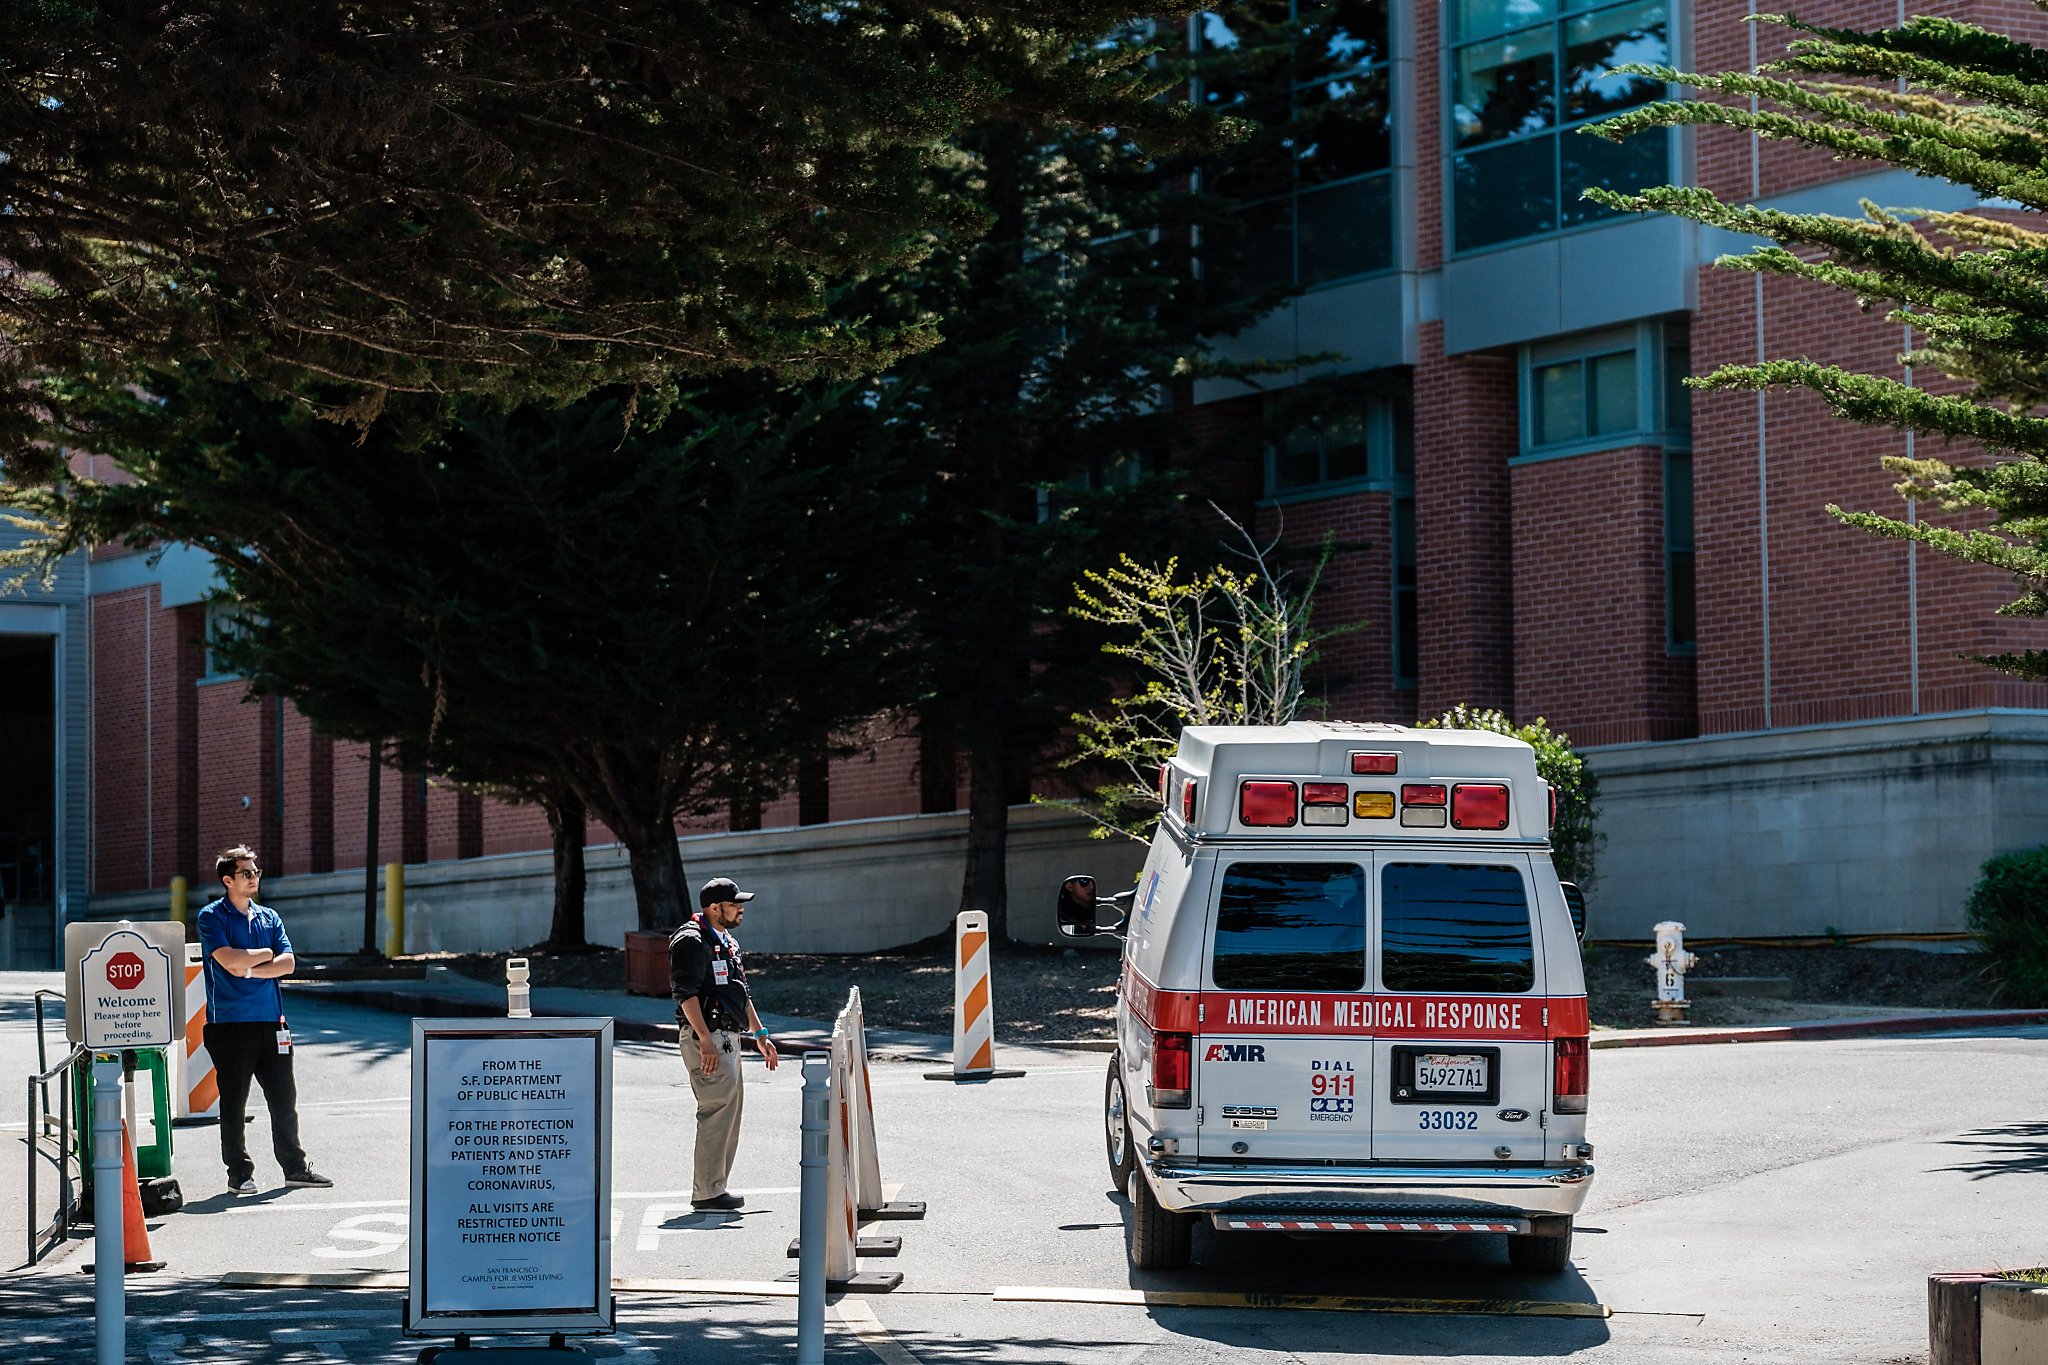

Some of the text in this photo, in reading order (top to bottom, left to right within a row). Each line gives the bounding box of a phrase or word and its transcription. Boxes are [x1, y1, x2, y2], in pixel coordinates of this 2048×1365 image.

[109, 964, 142, 979] STOP
[1666, 973, 1674, 987] 6
[98, 996, 156, 1008] Welcome
[94, 1010, 161, 1020] Please stop here
[1227, 999, 1521, 1029] AMERICAN MEDICAL RESPONSE
[114, 1021, 142, 1029] before
[104, 1030, 153, 1041] proceeding.
[1204, 1044, 1265, 1062] AMR
[482, 1060, 542, 1070] FROM THE
[1311, 1061, 1354, 1071] DIAL
[1430, 1057, 1474, 1069] California
[461, 1074, 562, 1086] S.F. DEPARTMENT
[1420, 1068, 1483, 1086] 54927A1
[1311, 1074, 1354, 1096] 9-1-1
[457, 1089, 566, 1101] OF PUBLIC HEALTH
[1310, 1114, 1353, 1122] EMERGENCY
[1419, 1111, 1478, 1130] 33032
[449, 1119, 574, 1131] FOR THE PROTECTION
[455, 1134, 568, 1146] OF OUR RESIDENTS,
[451, 1149, 572, 1161] PATIENTS AND STAFF
[482, 1165, 542, 1175] FROM THE
[467, 1179, 555, 1191] CORONAVIRUS,
[469, 1202, 554, 1214] ALL VISITS ARE
[458, 1217, 565, 1229] RESTRICTED UNTIL
[462, 1232, 561, 1243] FURTHER NOTICE
[539, 1273, 563, 1281] LIVING
